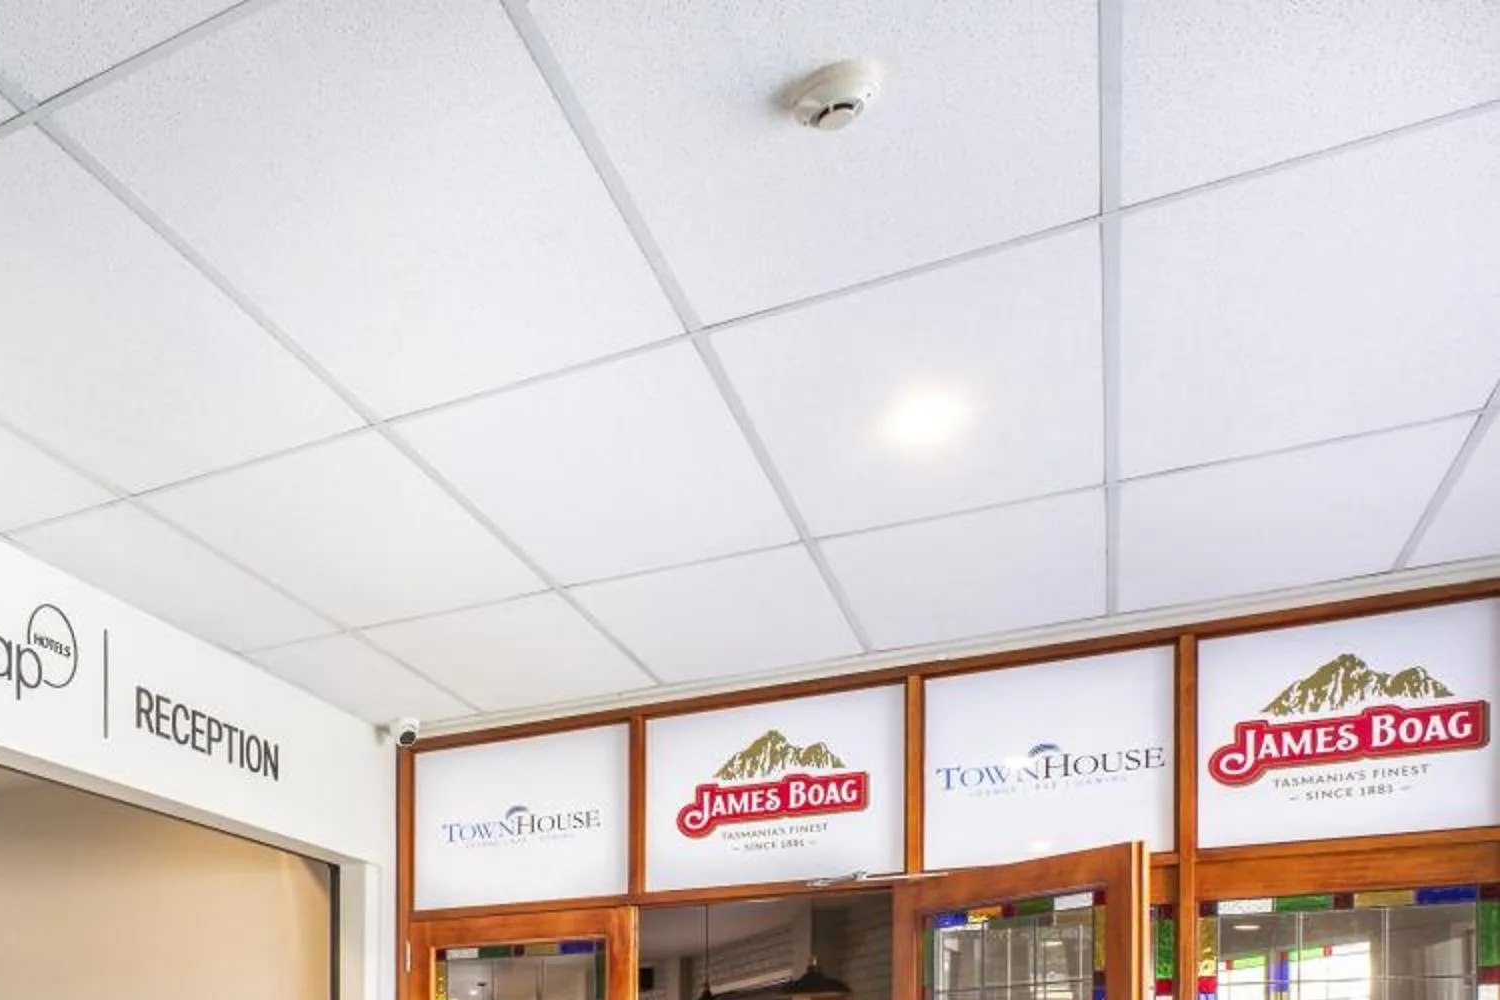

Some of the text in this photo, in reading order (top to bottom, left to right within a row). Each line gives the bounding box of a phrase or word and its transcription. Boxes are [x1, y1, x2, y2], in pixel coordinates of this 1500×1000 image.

[33, 633, 71, 658] HOTELS
[134, 685, 279, 781] RECEPTION
[1218, 711, 1473, 776] JAMES BOAG
[1273, 763, 1431, 789] TASMANIA'S FINEST
[684, 779, 858, 830] JAMES BOAG
[1305, 786, 1354, 801] SINCE
[789, 822, 829, 835] FINEST
